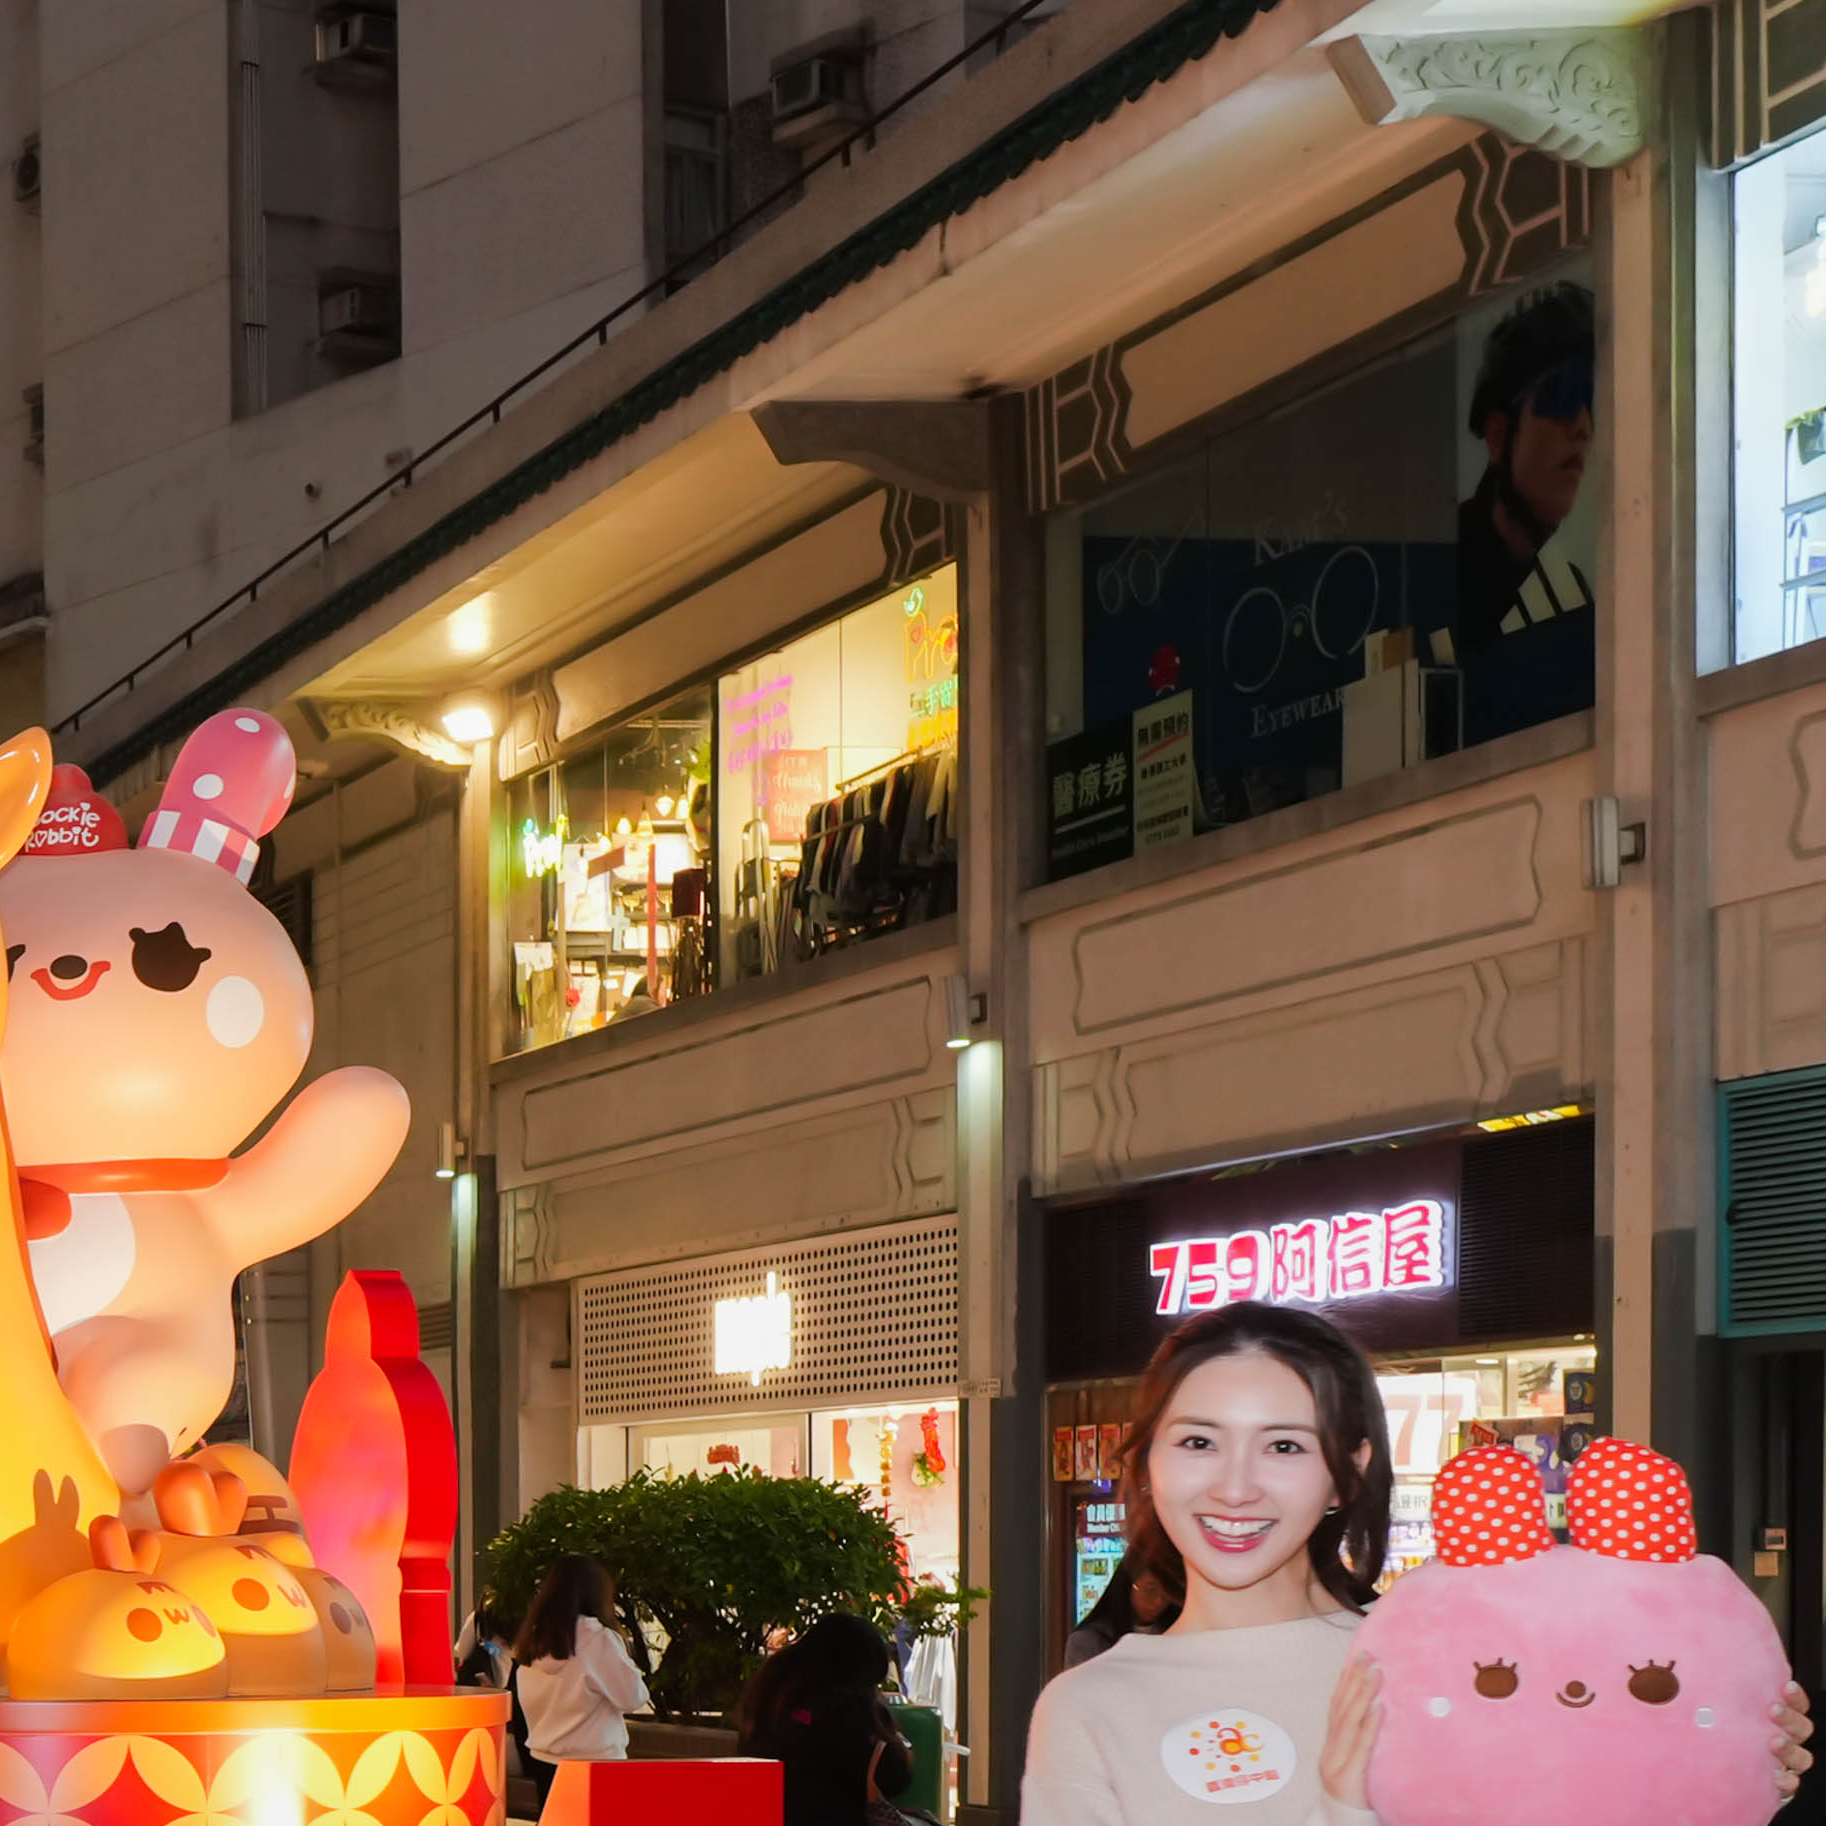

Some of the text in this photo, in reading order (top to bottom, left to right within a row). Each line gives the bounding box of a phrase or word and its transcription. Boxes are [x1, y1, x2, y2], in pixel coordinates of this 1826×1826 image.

[36, 802, 101, 828] ockie
[1052, 752, 1126, 820] 醫療券
[1150, 1199, 1444, 1316] 759阿信屋
